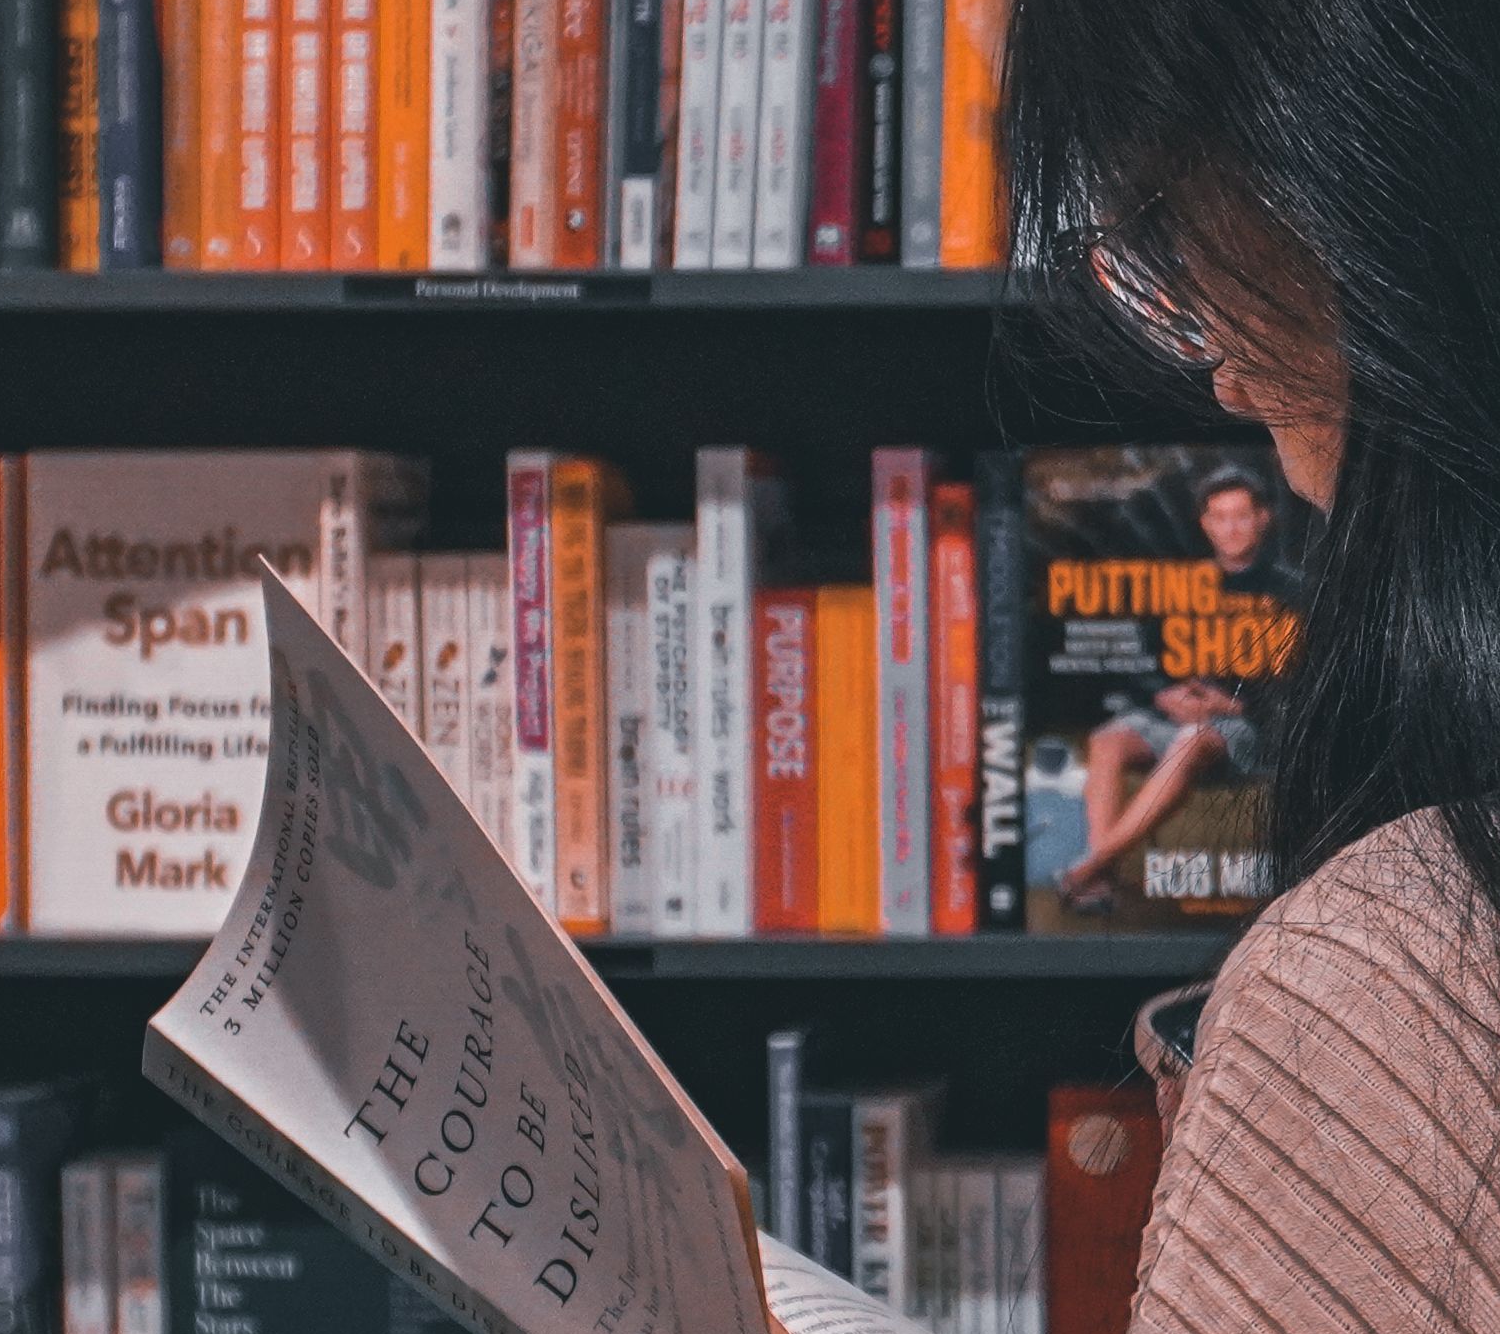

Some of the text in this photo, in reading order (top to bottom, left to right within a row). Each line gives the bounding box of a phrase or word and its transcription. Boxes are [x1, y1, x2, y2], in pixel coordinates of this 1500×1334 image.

[415, 279, 579, 301] Personal Development
[104, 592, 250, 657] Span
[1048, 560, 1222, 616] PUTTING
[61, 694, 240, 719] Finding Focus
[669, 603, 688, 754] PSYCHOLOGY
[764, 605, 806, 780] PURPOSE
[105, 792, 243, 833] Gloria
[980, 718, 1020, 860] WALL
[116, 847, 229, 893] Mark
[199, 800, 296, 1018] THE INTERNATIONAL
[224, 725, 320, 1036] 3 MILLION COPIES SOLD
[344, 1019, 431, 1145] THE
[413, 933, 494, 1197] COURAGE
[468, 1081, 548, 1247] TO BE
[533, 1051, 601, 1307] DISLIKED
[194, 1251, 296, 1279] Between
[195, 1221, 267, 1248] Space
[364, 1222, 400, 1257] TO
